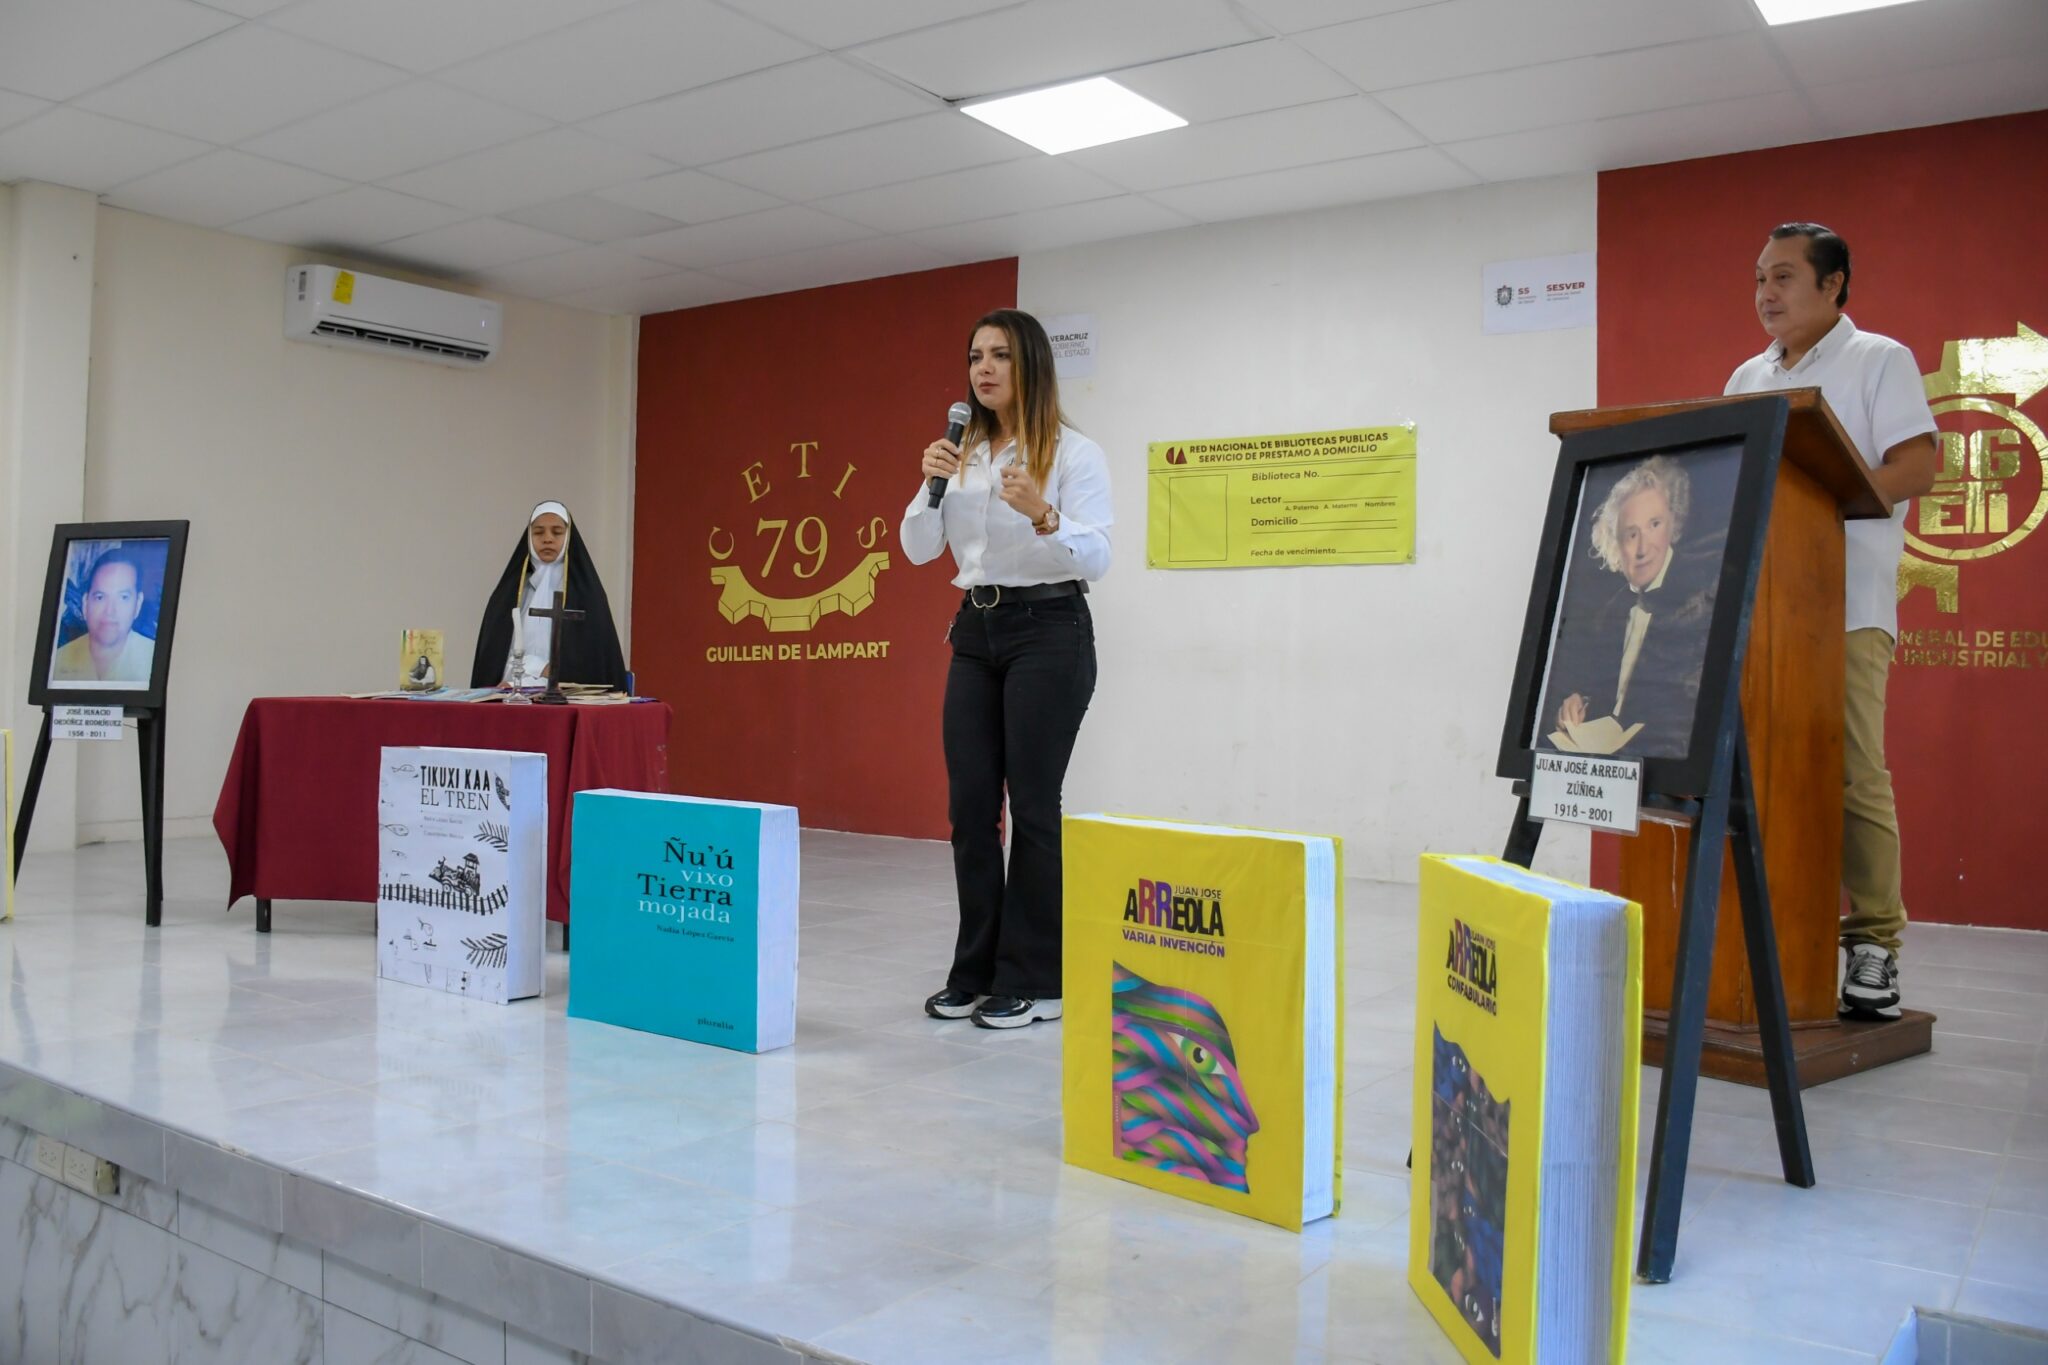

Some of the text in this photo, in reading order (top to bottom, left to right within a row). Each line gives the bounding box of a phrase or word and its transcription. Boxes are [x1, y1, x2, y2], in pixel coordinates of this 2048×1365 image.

[1518, 287, 1530, 295] SS
[1546, 282, 1585, 292] SESVER
[1050, 332, 1089, 342] VERACRUZ
[1190, 432, 1389, 453] RED NACIONAL DE BIBLIOTECAS PUBLICAS
[1199, 444, 1377, 462] SERVICIO DE PRESTAMO A DOMICILIO
[1252, 470, 1319, 481] Biblioteca No.
[1250, 496, 1281, 504] Lector
[1251, 516, 1298, 526] Domicilio
[756, 515, 829, 579] 79
[1250, 546, 1337, 557] Fecha de vencimiento
[1975, 630, 2005, 648] DE
[706, 641, 890, 663] GUILLEN DE LAMPART
[420, 765, 491, 792] TIKUXI KAA
[1536, 758, 1638, 780] JUAN JOSÉ ARREOLA
[420, 788, 491, 811] EL TREN
[1566, 780, 1604, 799] ZÚÑIGA
[1554, 803, 1578, 818] 1918
[1588, 807, 1613, 823] 2001
[681, 867, 734, 887] vixo
[637, 873, 733, 906] Tierra
[1175, 885, 1199, 897] JUAN
[638, 899, 731, 924] mojada
[1123, 878, 1225, 936] ARREOLA
[656, 924, 681, 934] Nadia
[1122, 928, 1225, 958] VARIA INVENCIÓN
[1446, 918, 1497, 998] ARREOLA
[1447, 974, 1497, 1017] CONFABULARIO
